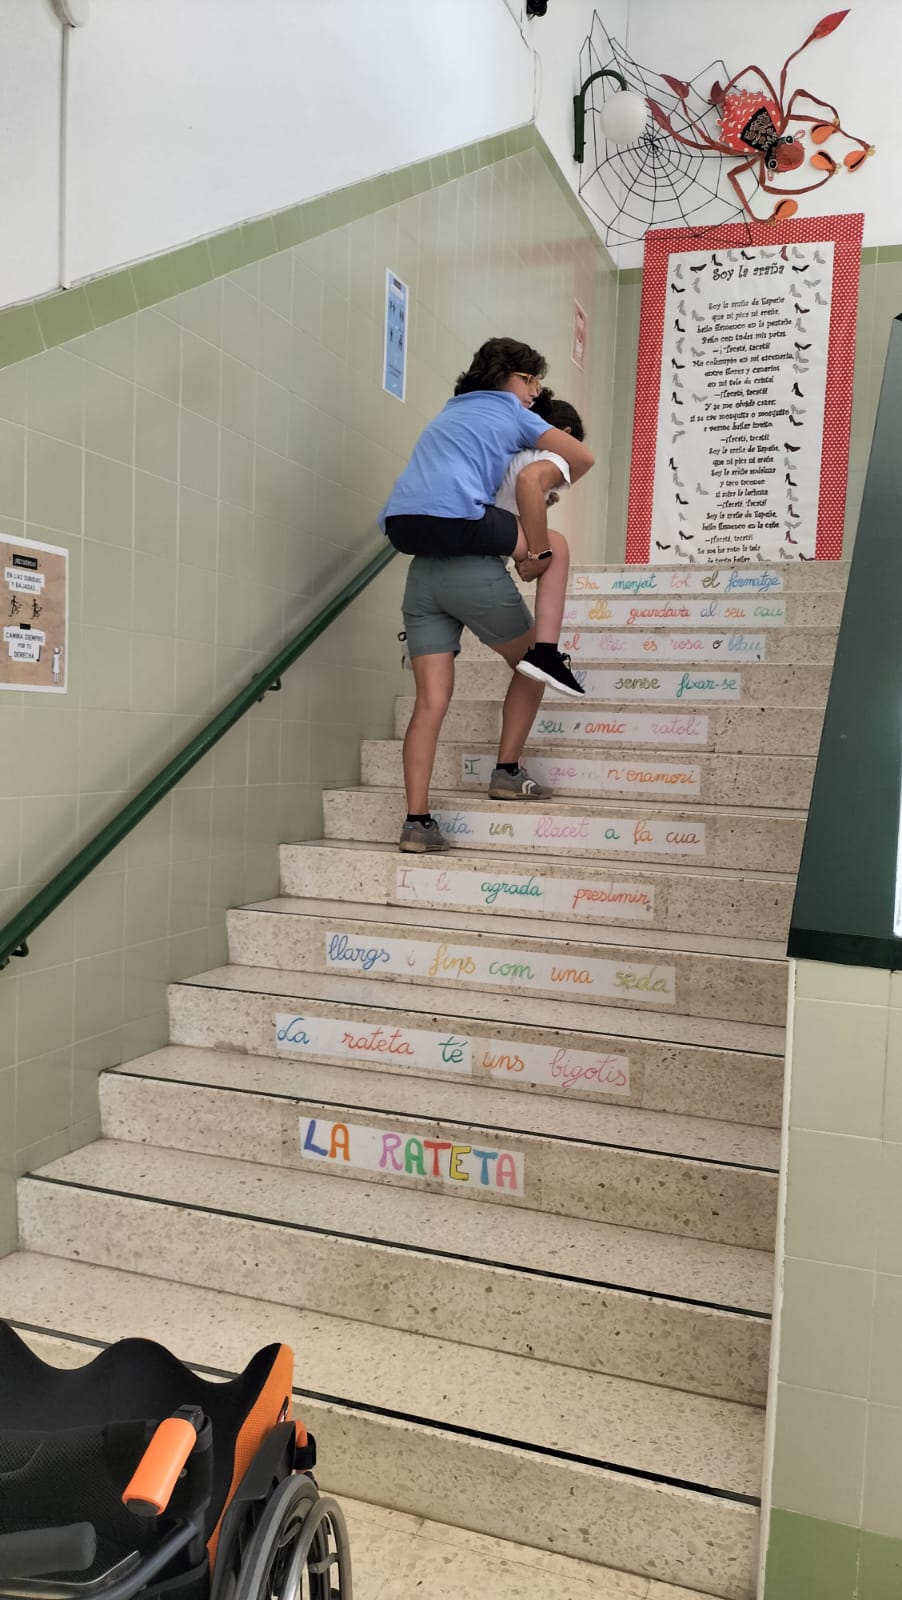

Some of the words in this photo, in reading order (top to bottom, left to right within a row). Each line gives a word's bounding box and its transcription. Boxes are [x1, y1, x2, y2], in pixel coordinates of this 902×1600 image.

[712, 268, 734, 280] Soy
[739, 265, 748, 278] la
[753, 263, 784, 276] araña
[752, 298, 759, 306] de
[736, 333, 753, 341] todas
[611, 573, 658, 593] menjat
[670, 573, 692, 588] tot
[702, 570, 720, 588] el
[725, 570, 781, 592] formatge
[700, 600, 719, 618] al
[724, 607, 746, 618] seu
[753, 606, 784, 616] cau
[563, 633, 581, 650] el
[712, 639, 723, 650] o
[614, 676, 661, 690] sense
[676, 673, 738, 698] fixar-se
[537, 719, 564, 734] seu
[584, 721, 627, 734] amic
[549, 766, 578, 785] que
[489, 822, 514, 837] un
[535, 816, 590, 839] llacet
[604, 827, 620, 840] a
[634, 820, 653, 844] la
[665, 831, 700, 844] cua
[480, 876, 543, 904] agrada
[573, 884, 650, 908] presumir
[328, 934, 391, 970] llargs
[428, 943, 476, 976] fins
[488, 961, 534, 981] com
[550, 967, 594, 984] una
[614, 966, 672, 993] seda
[277, 1017, 310, 1045] La
[341, 1026, 414, 1056] rateta
[439, 1035, 469, 1064] té
[482, 1051, 525, 1073] uns
[550, 1048, 627, 1088] bigotis
[303, 1118, 351, 1162] LA
[379, 1132, 518, 1191] RATETA
